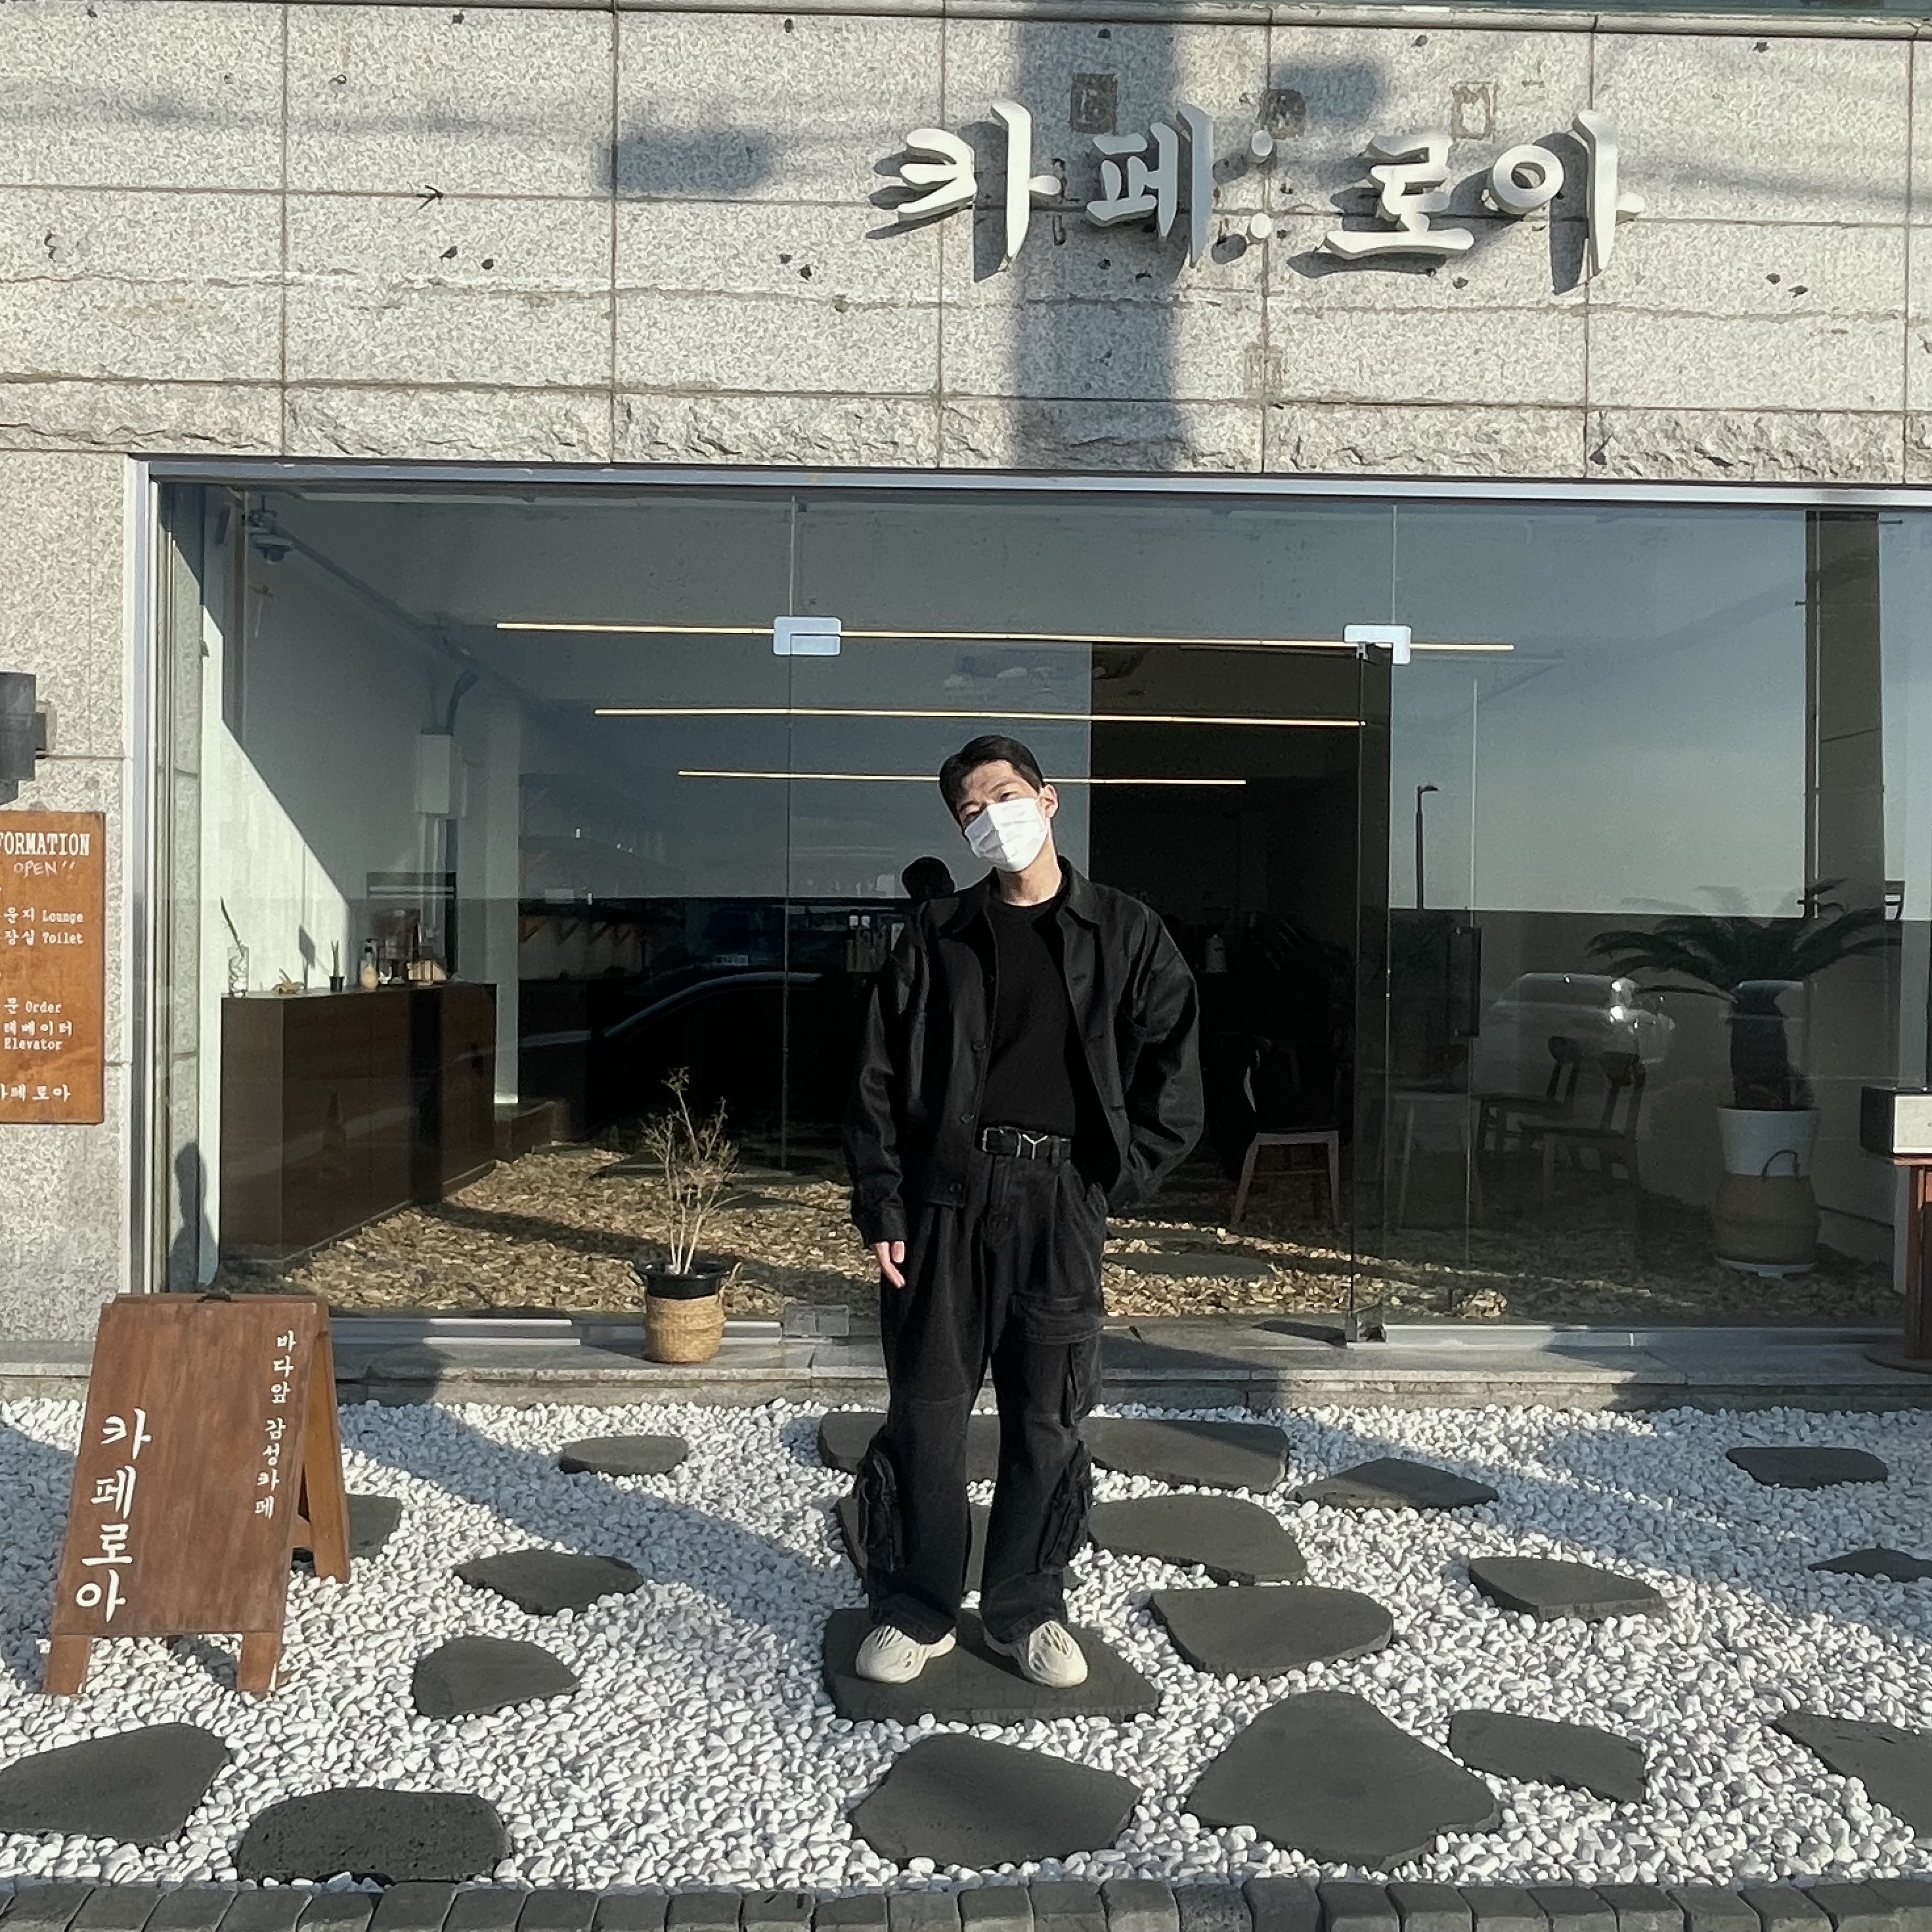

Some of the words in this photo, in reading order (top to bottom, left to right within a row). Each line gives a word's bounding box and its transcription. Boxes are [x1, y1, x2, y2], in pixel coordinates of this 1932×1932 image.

[42, 909, 84, 925] Lounge
[0, 928, 35, 946] 장실
[42, 931, 84, 945] Toilet
[25, 999, 62, 1014] Order
[3, 1036, 64, 1051] Elevator
